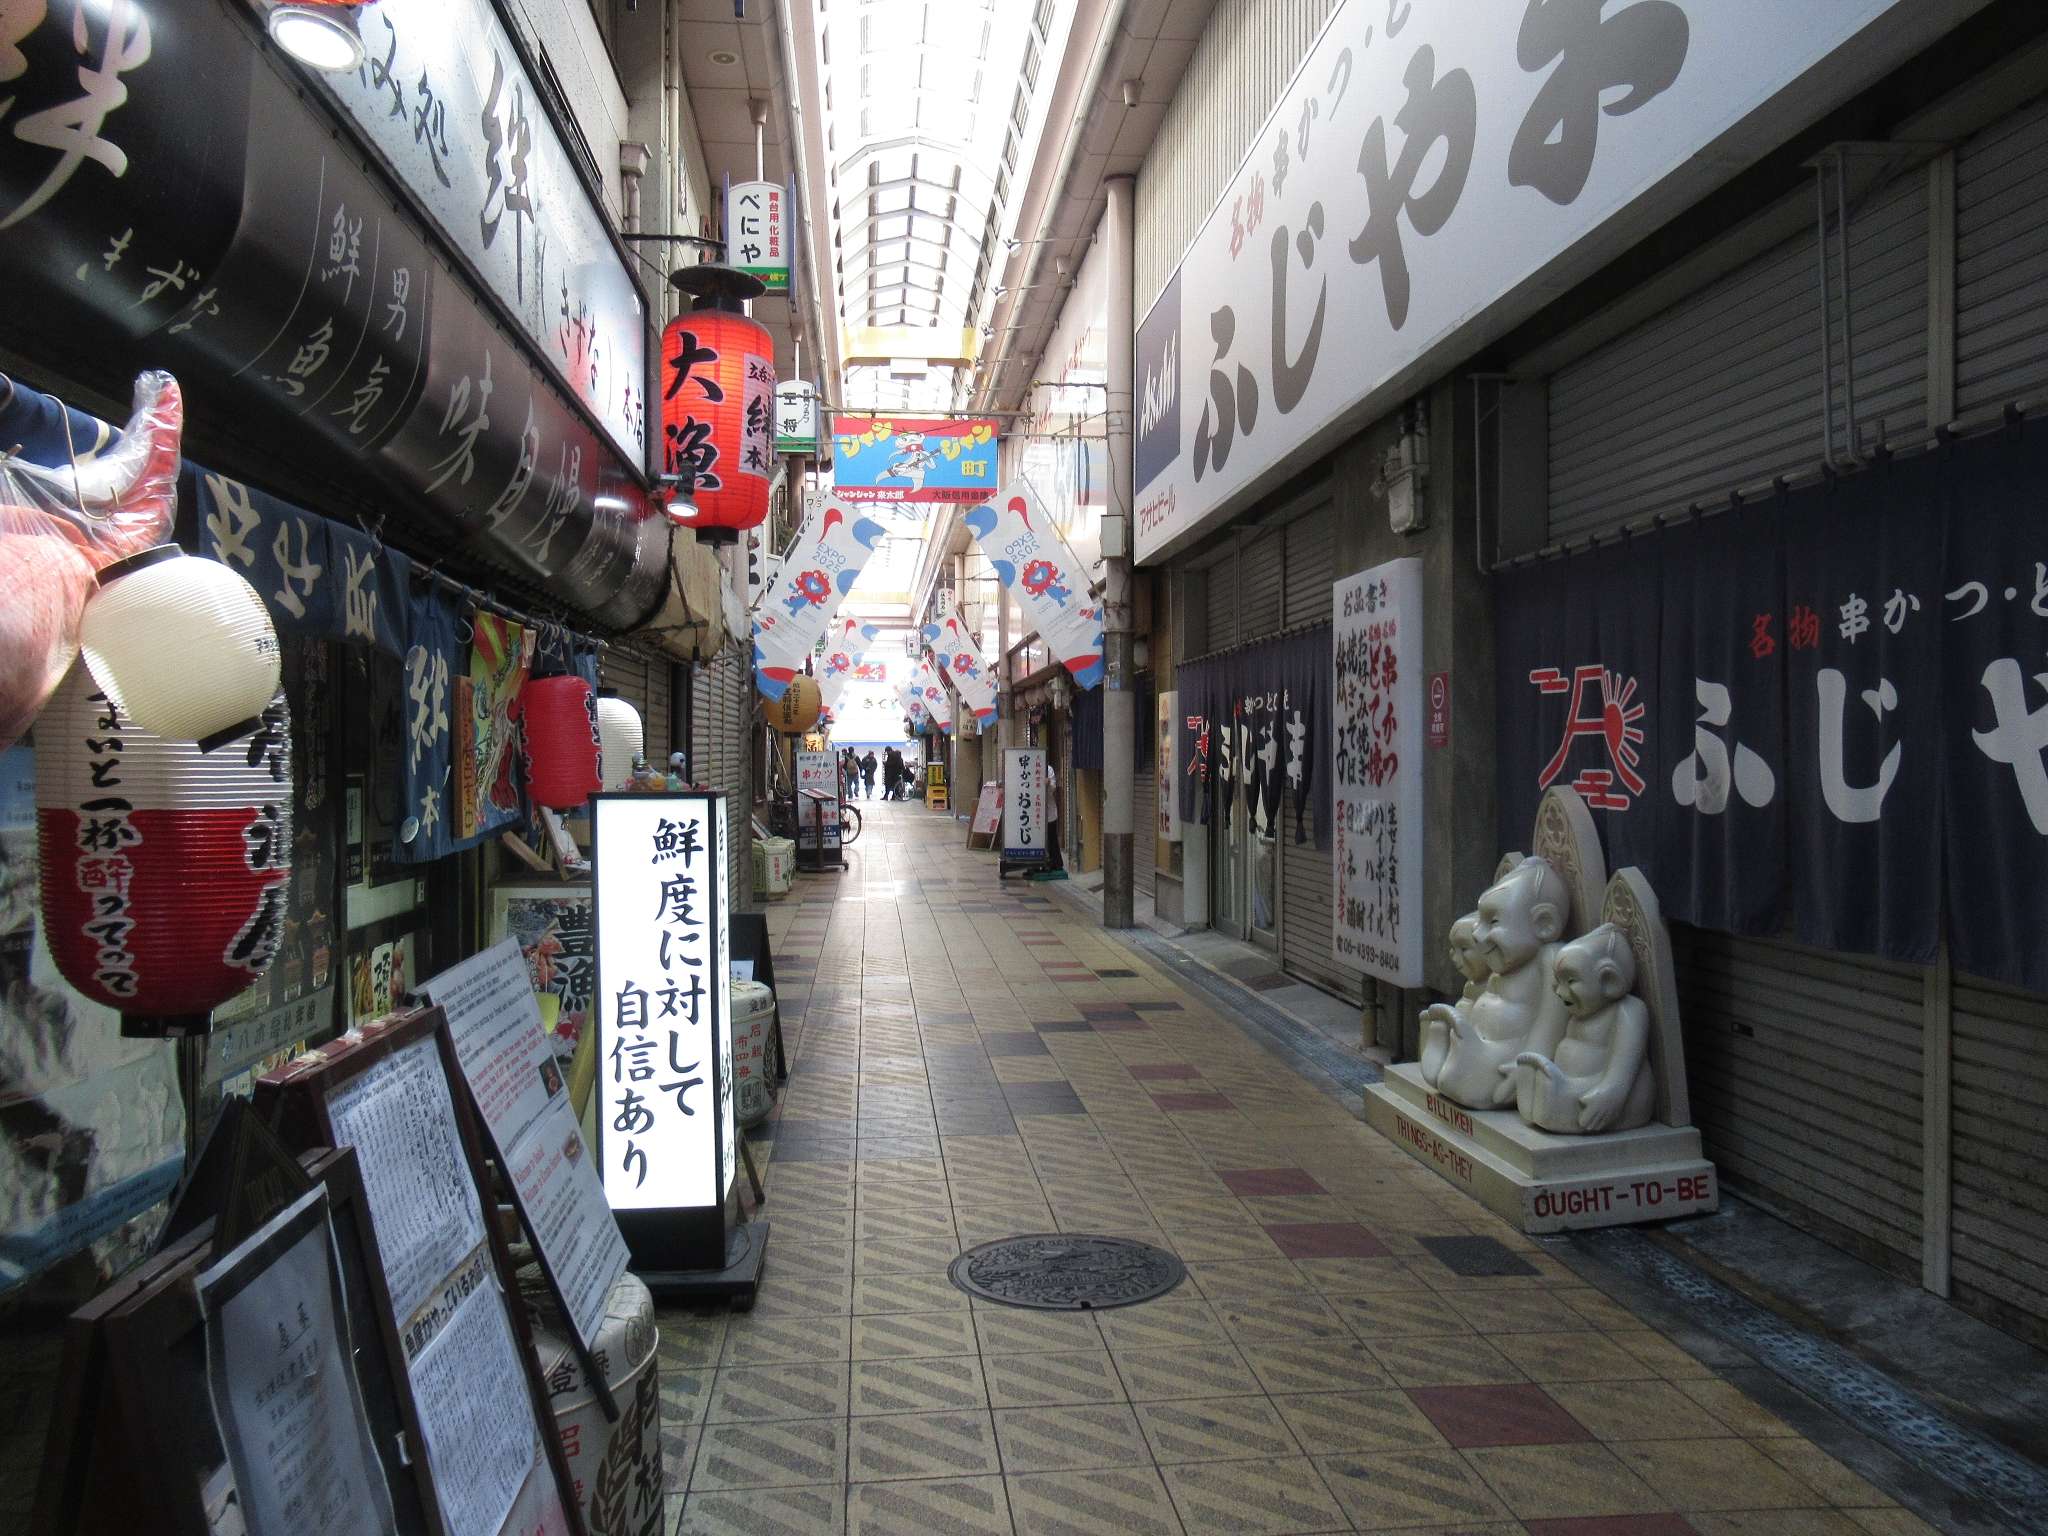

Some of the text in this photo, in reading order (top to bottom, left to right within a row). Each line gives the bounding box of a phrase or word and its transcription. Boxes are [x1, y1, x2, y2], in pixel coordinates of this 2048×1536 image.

[739, 194, 761, 264] べにや
[1230, 171, 1265, 260] 名物
[1140, 329, 1177, 443] Asahi
[1139, 482, 1177, 537] アサヒビール
[812, 551, 841, 574] 2025
[817, 542, 846, 565] EXPO
[1343, 578, 1388, 618] お品書き
[1750, 560, 2048, 659] 名物 串かつ・
[1381, 645, 1399, 785] 串かつ
[651, 817, 706, 1117] 鮮度に対して
[608, 980, 658, 1189] 自信あり
[1426, 1093, 1474, 1138] BILLIKEN
[1395, 1114, 1474, 1185] THINGS-AS-THEY
[1534, 1175, 1710, 1218] OUGHT-TO-BE
